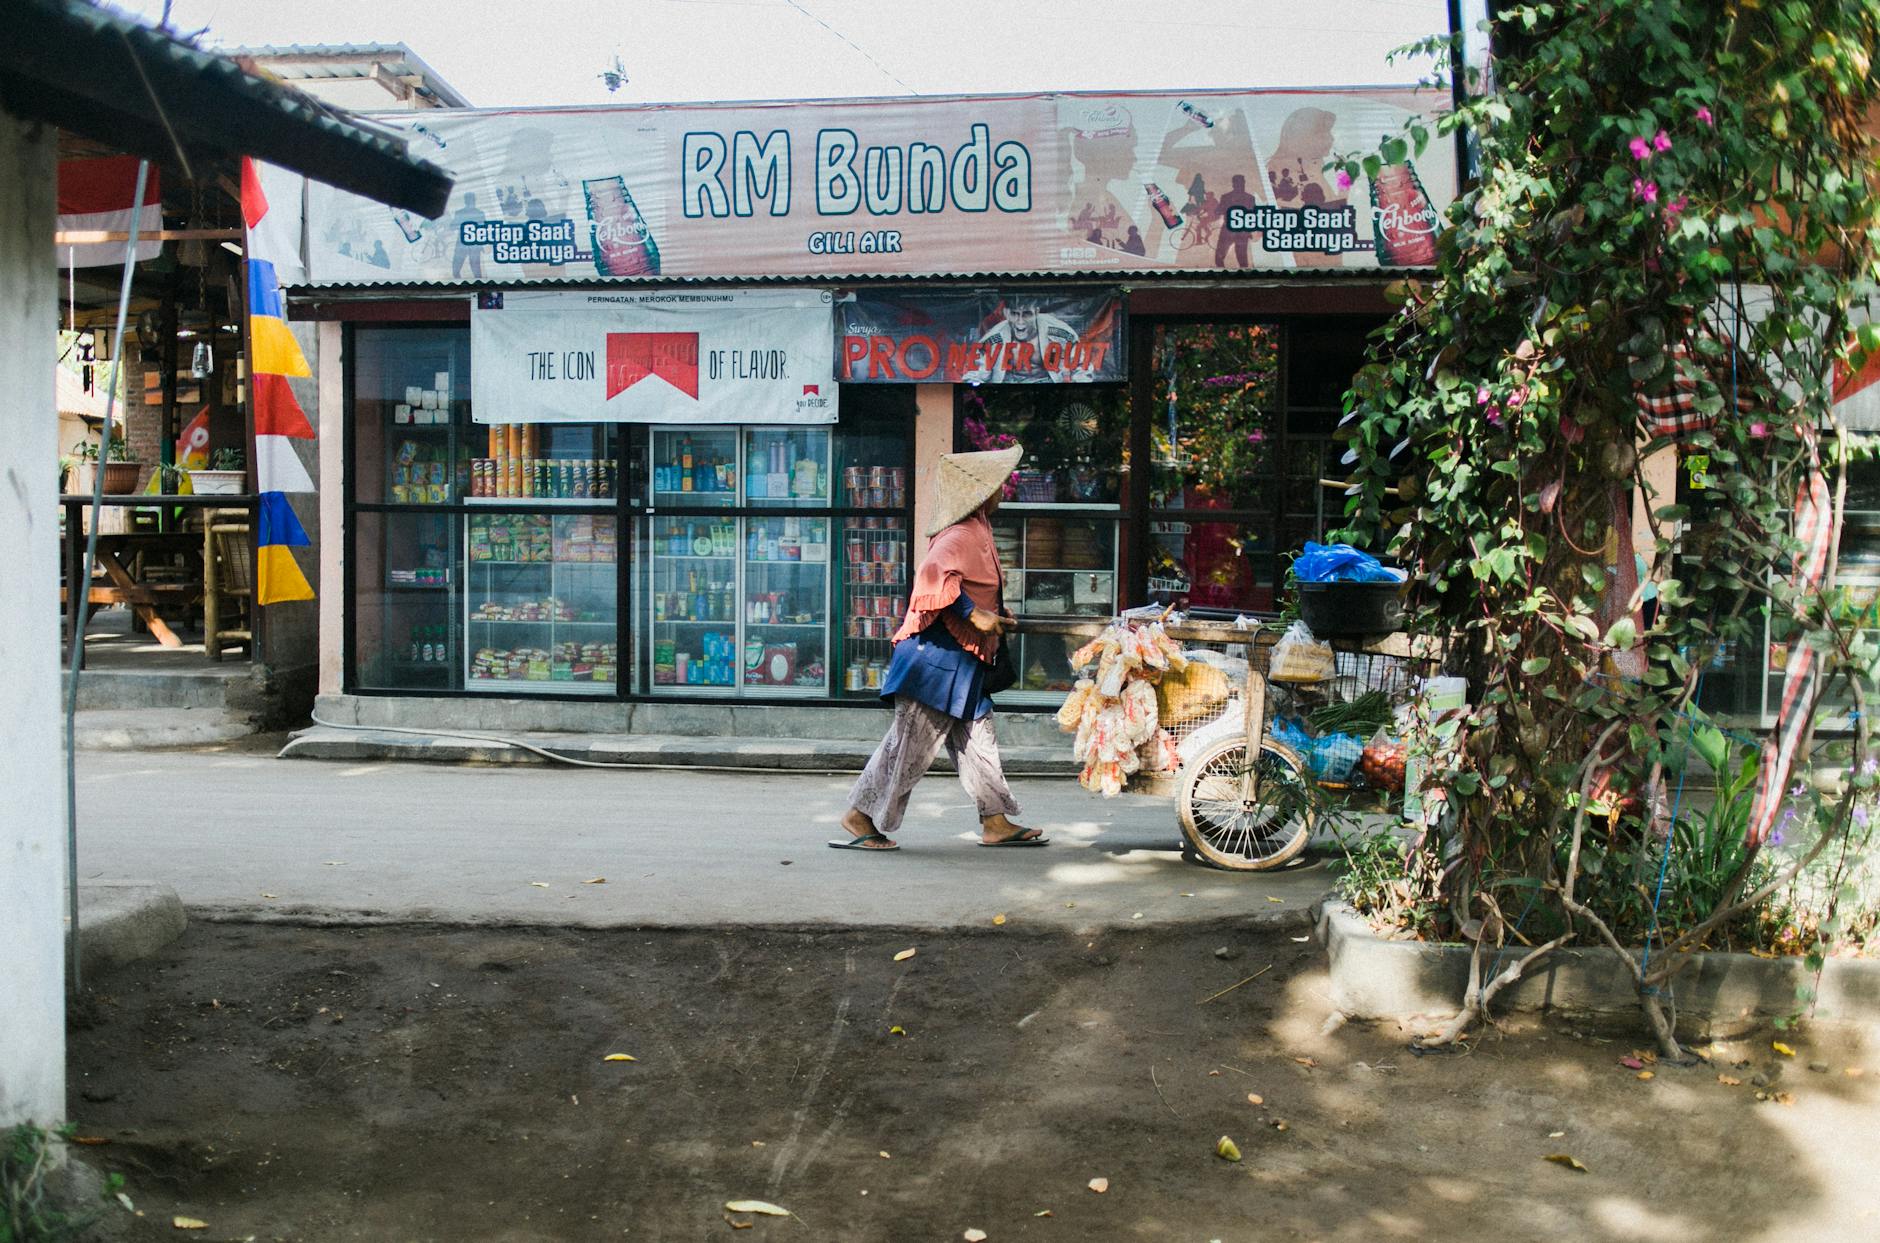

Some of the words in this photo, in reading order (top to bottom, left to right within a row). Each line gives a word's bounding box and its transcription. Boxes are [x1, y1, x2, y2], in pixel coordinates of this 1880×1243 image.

[682, 130, 791, 218] RM
[815, 123, 1032, 216] Bunda
[1230, 209, 1298, 231] Setiap
[1303, 208, 1352, 229] Saat
[463, 223, 523, 244] Setiap
[528, 222, 572, 242] Saat
[808, 231, 855, 254] GILI
[860, 230, 903, 253] AIR
[1266, 230, 1375, 252] Saatnya...
[496, 243, 593, 263] Saatnya...
[639, 295, 677, 303] MEROKOK
[678, 295, 734, 303] MEMBUNUHMU
[848, 322, 880, 337] Surya
[527, 352, 555, 381] THE
[562, 351, 595, 381] ICON
[709, 350, 726, 380] OF
[732, 350, 791, 380] FLAVOR.
[841, 335, 940, 380] PRO
[946, 341, 1035, 373] NEVER
[1043, 341, 1110, 373] QUIT
